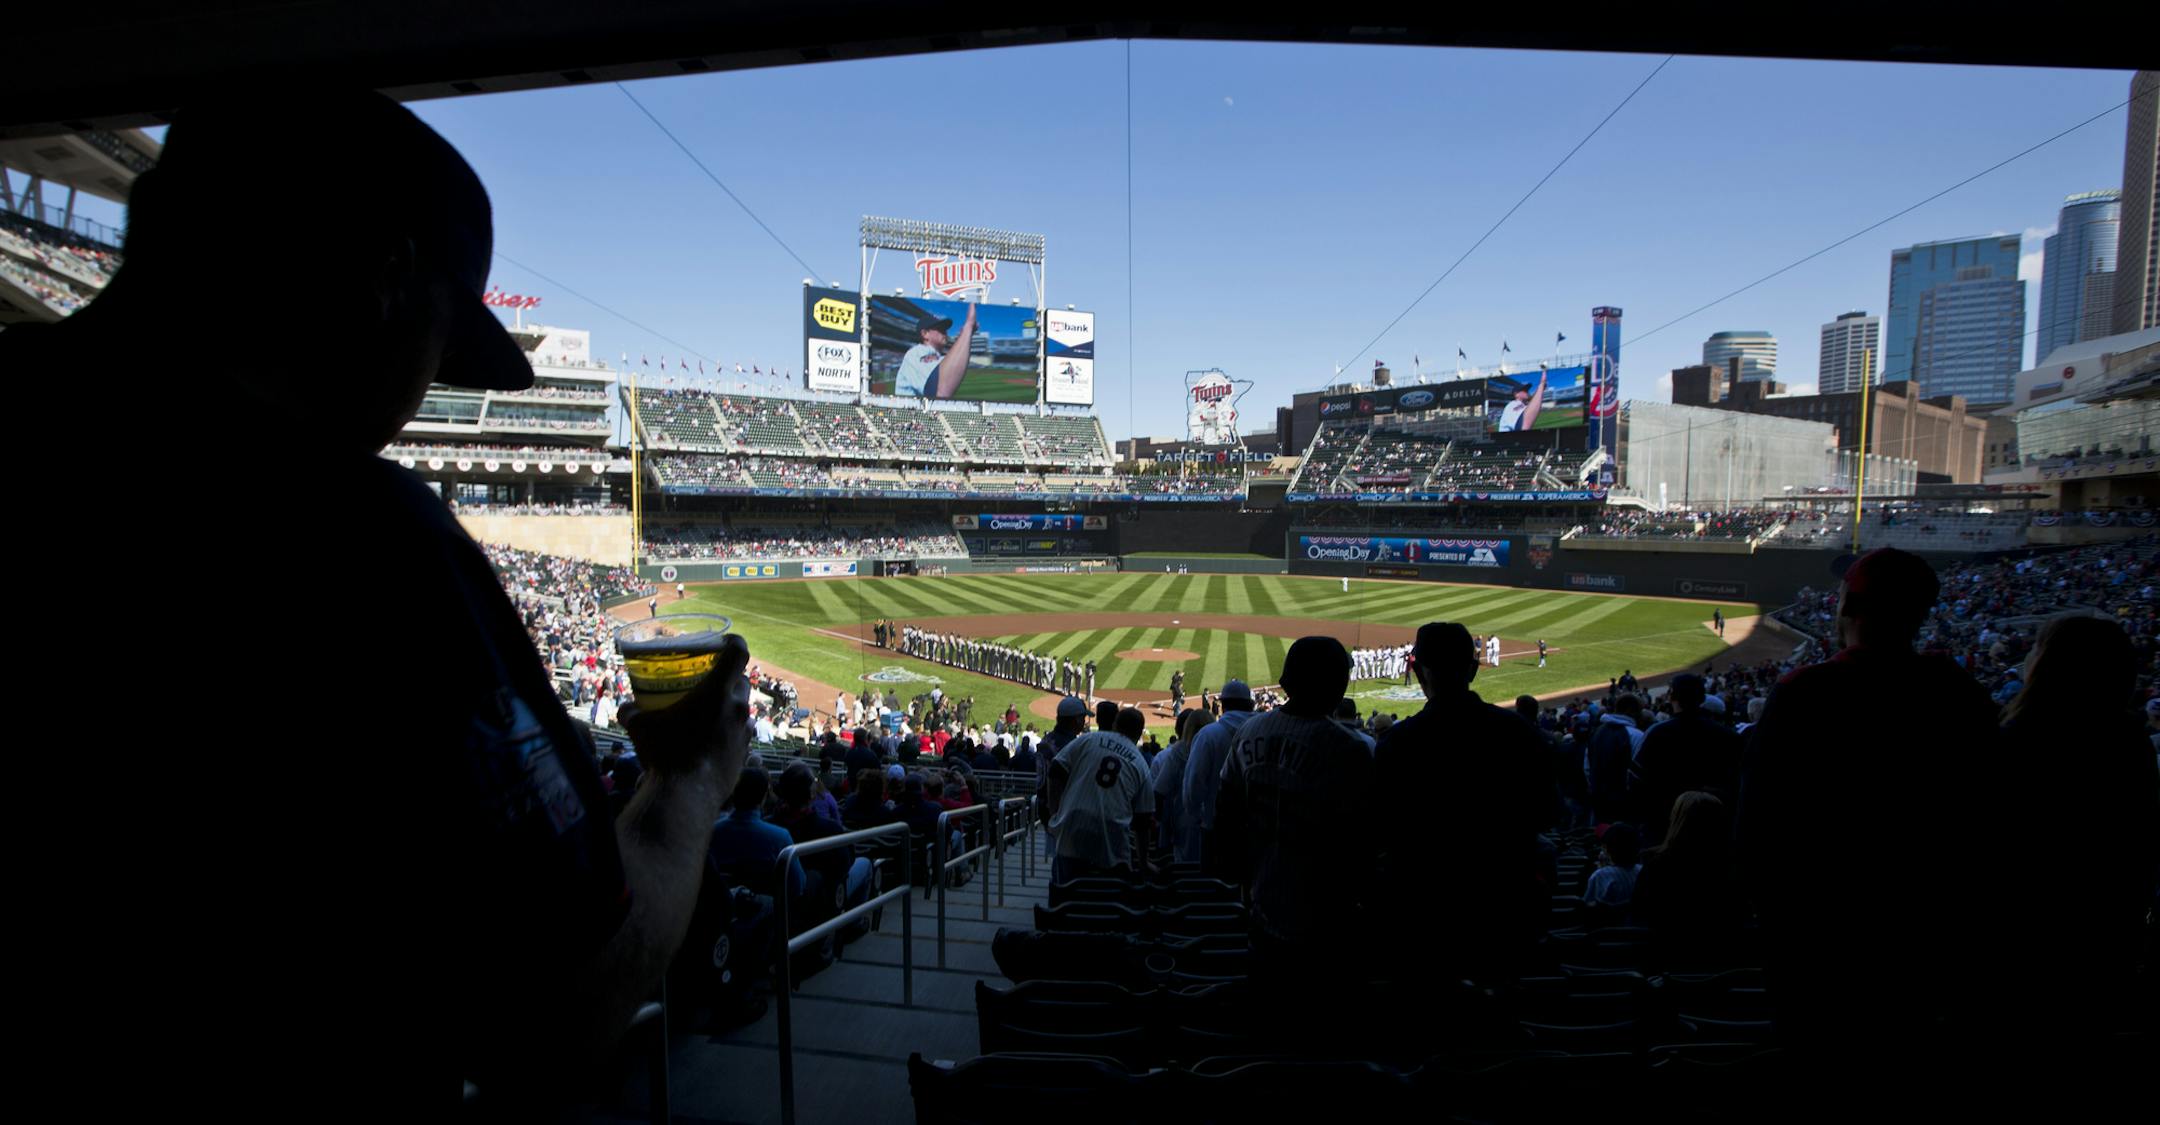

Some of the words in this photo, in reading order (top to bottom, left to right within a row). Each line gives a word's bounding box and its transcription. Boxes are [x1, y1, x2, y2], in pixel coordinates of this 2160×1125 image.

[916, 255, 996, 291] Twins
[820, 304, 853, 318] BEST
[821, 314, 849, 326] BUY
[825, 347, 844, 358] FOX
[817, 367, 852, 379] NORTH
[1191, 383, 1232, 403] Twins
[1452, 389, 1482, 399] DELTA
[1331, 400, 1351, 412] pepsi
[1155, 453, 1214, 463] TARGET
[1230, 453, 1274, 463] FIELD
[1537, 493, 1589, 502] SUPERAMERICA
[1429, 552, 1457, 561] PRESENTED
[1458, 553, 1466, 561] BY
[1100, 737, 1136, 763] LERUM
[1096, 756, 1121, 788] 8
